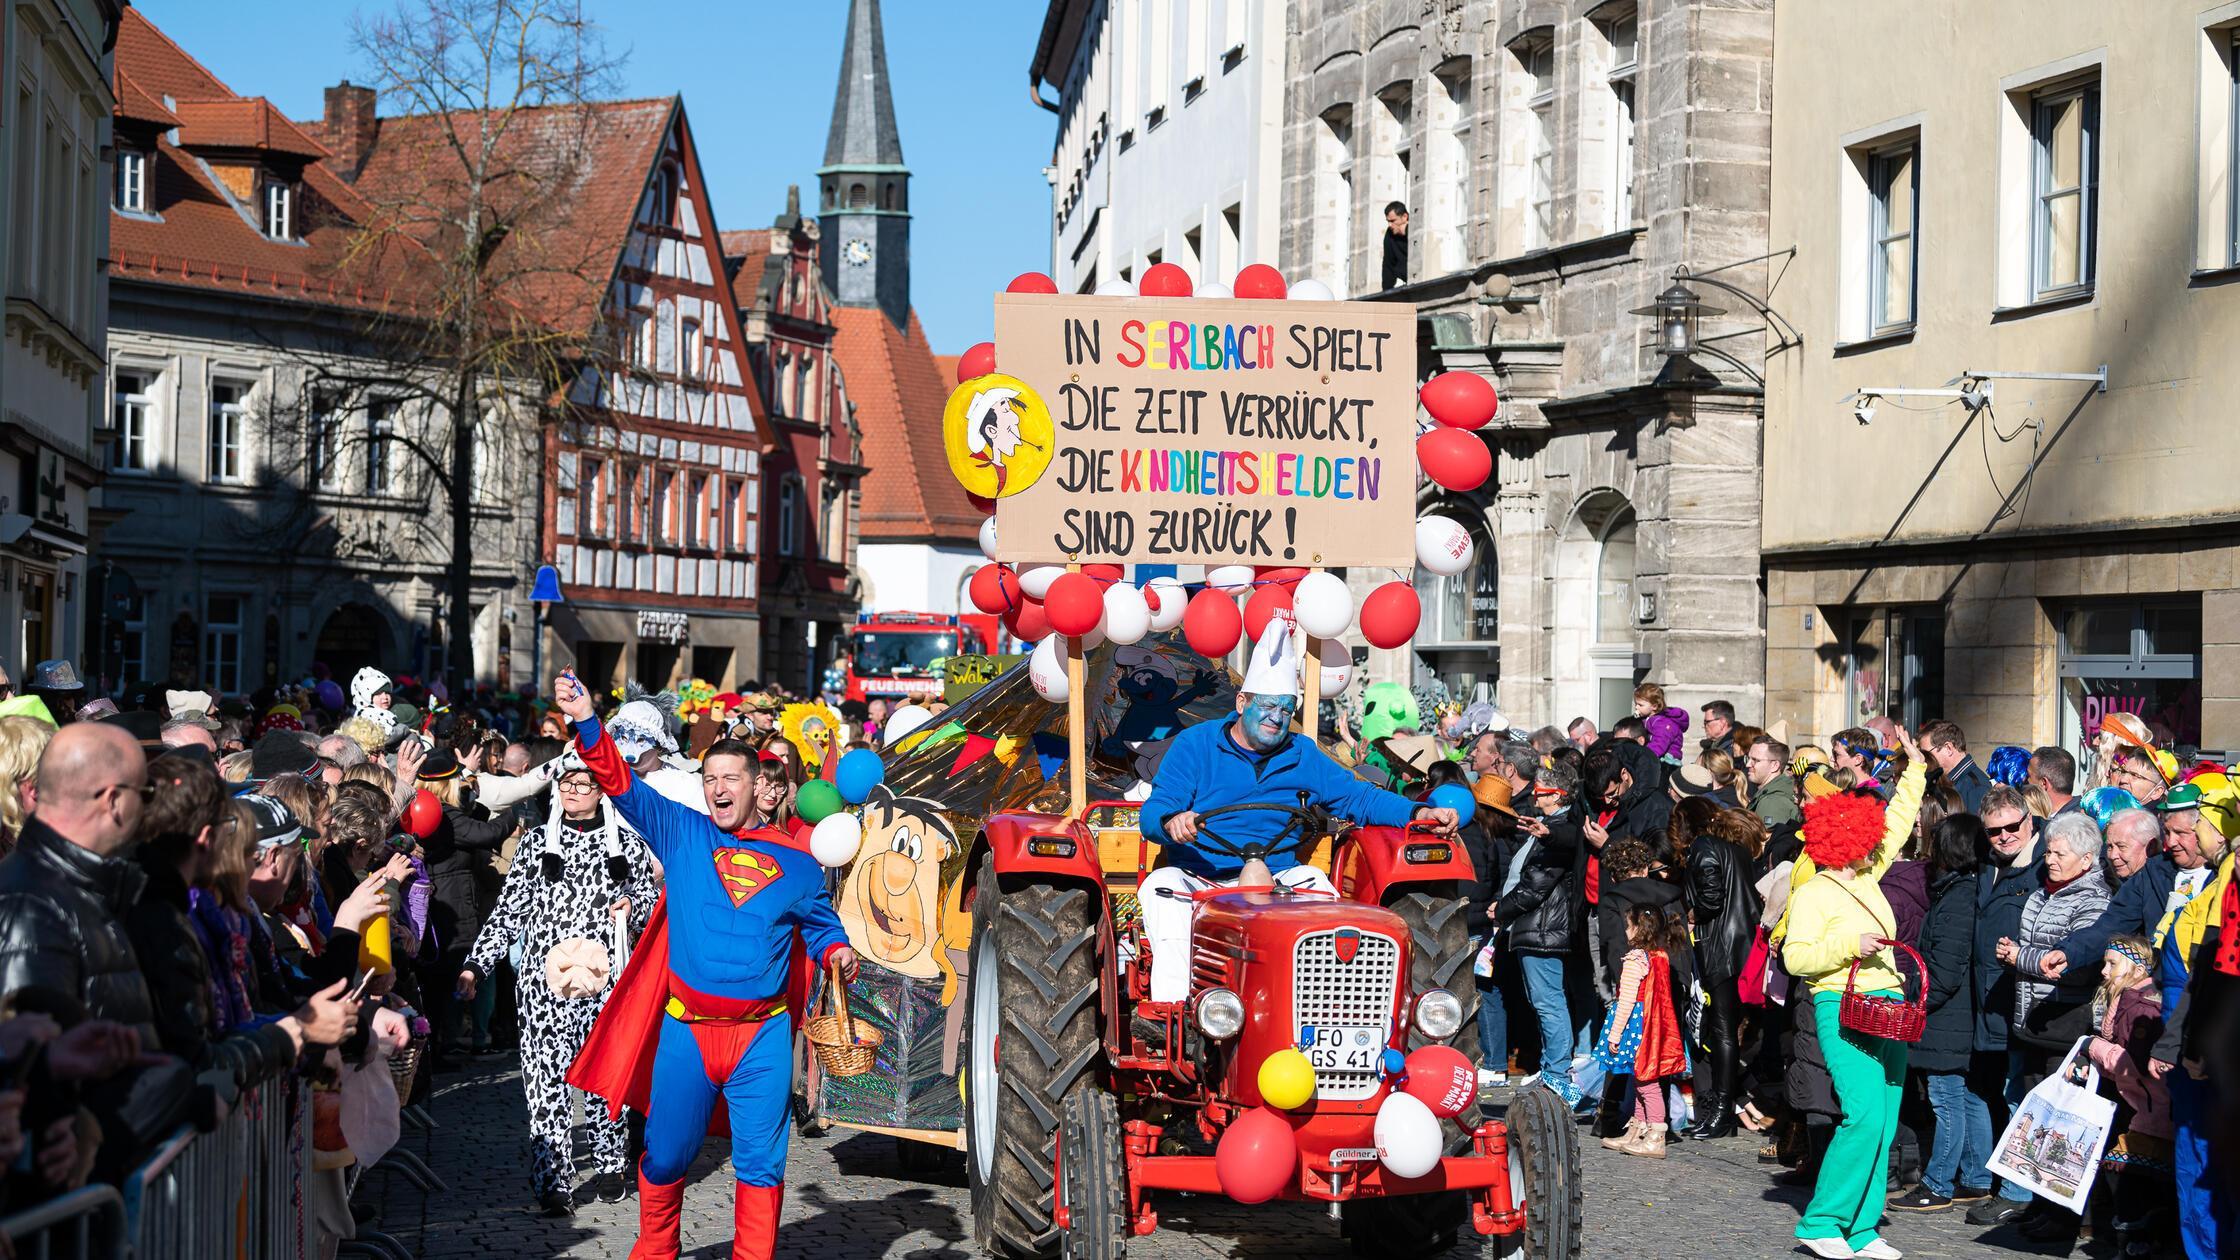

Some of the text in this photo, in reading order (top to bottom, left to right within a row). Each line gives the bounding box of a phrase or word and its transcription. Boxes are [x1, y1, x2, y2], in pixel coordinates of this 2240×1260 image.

[1064, 318, 1392, 374] IN SERLBACH SPIELT
[1058, 382, 1379, 449] DIE ZEIT VERRÜCKT,
[1057, 450, 1381, 502] DIE KINDHEITSHELDEN
[1053, 508, 1134, 556] SIND
[1311, 1050, 1371, 1068] GS 41
[1316, 1029, 1343, 1047] FO
[1450, 1069, 1474, 1112] REWE
[1335, 1149, 1371, 1159] Güldner
